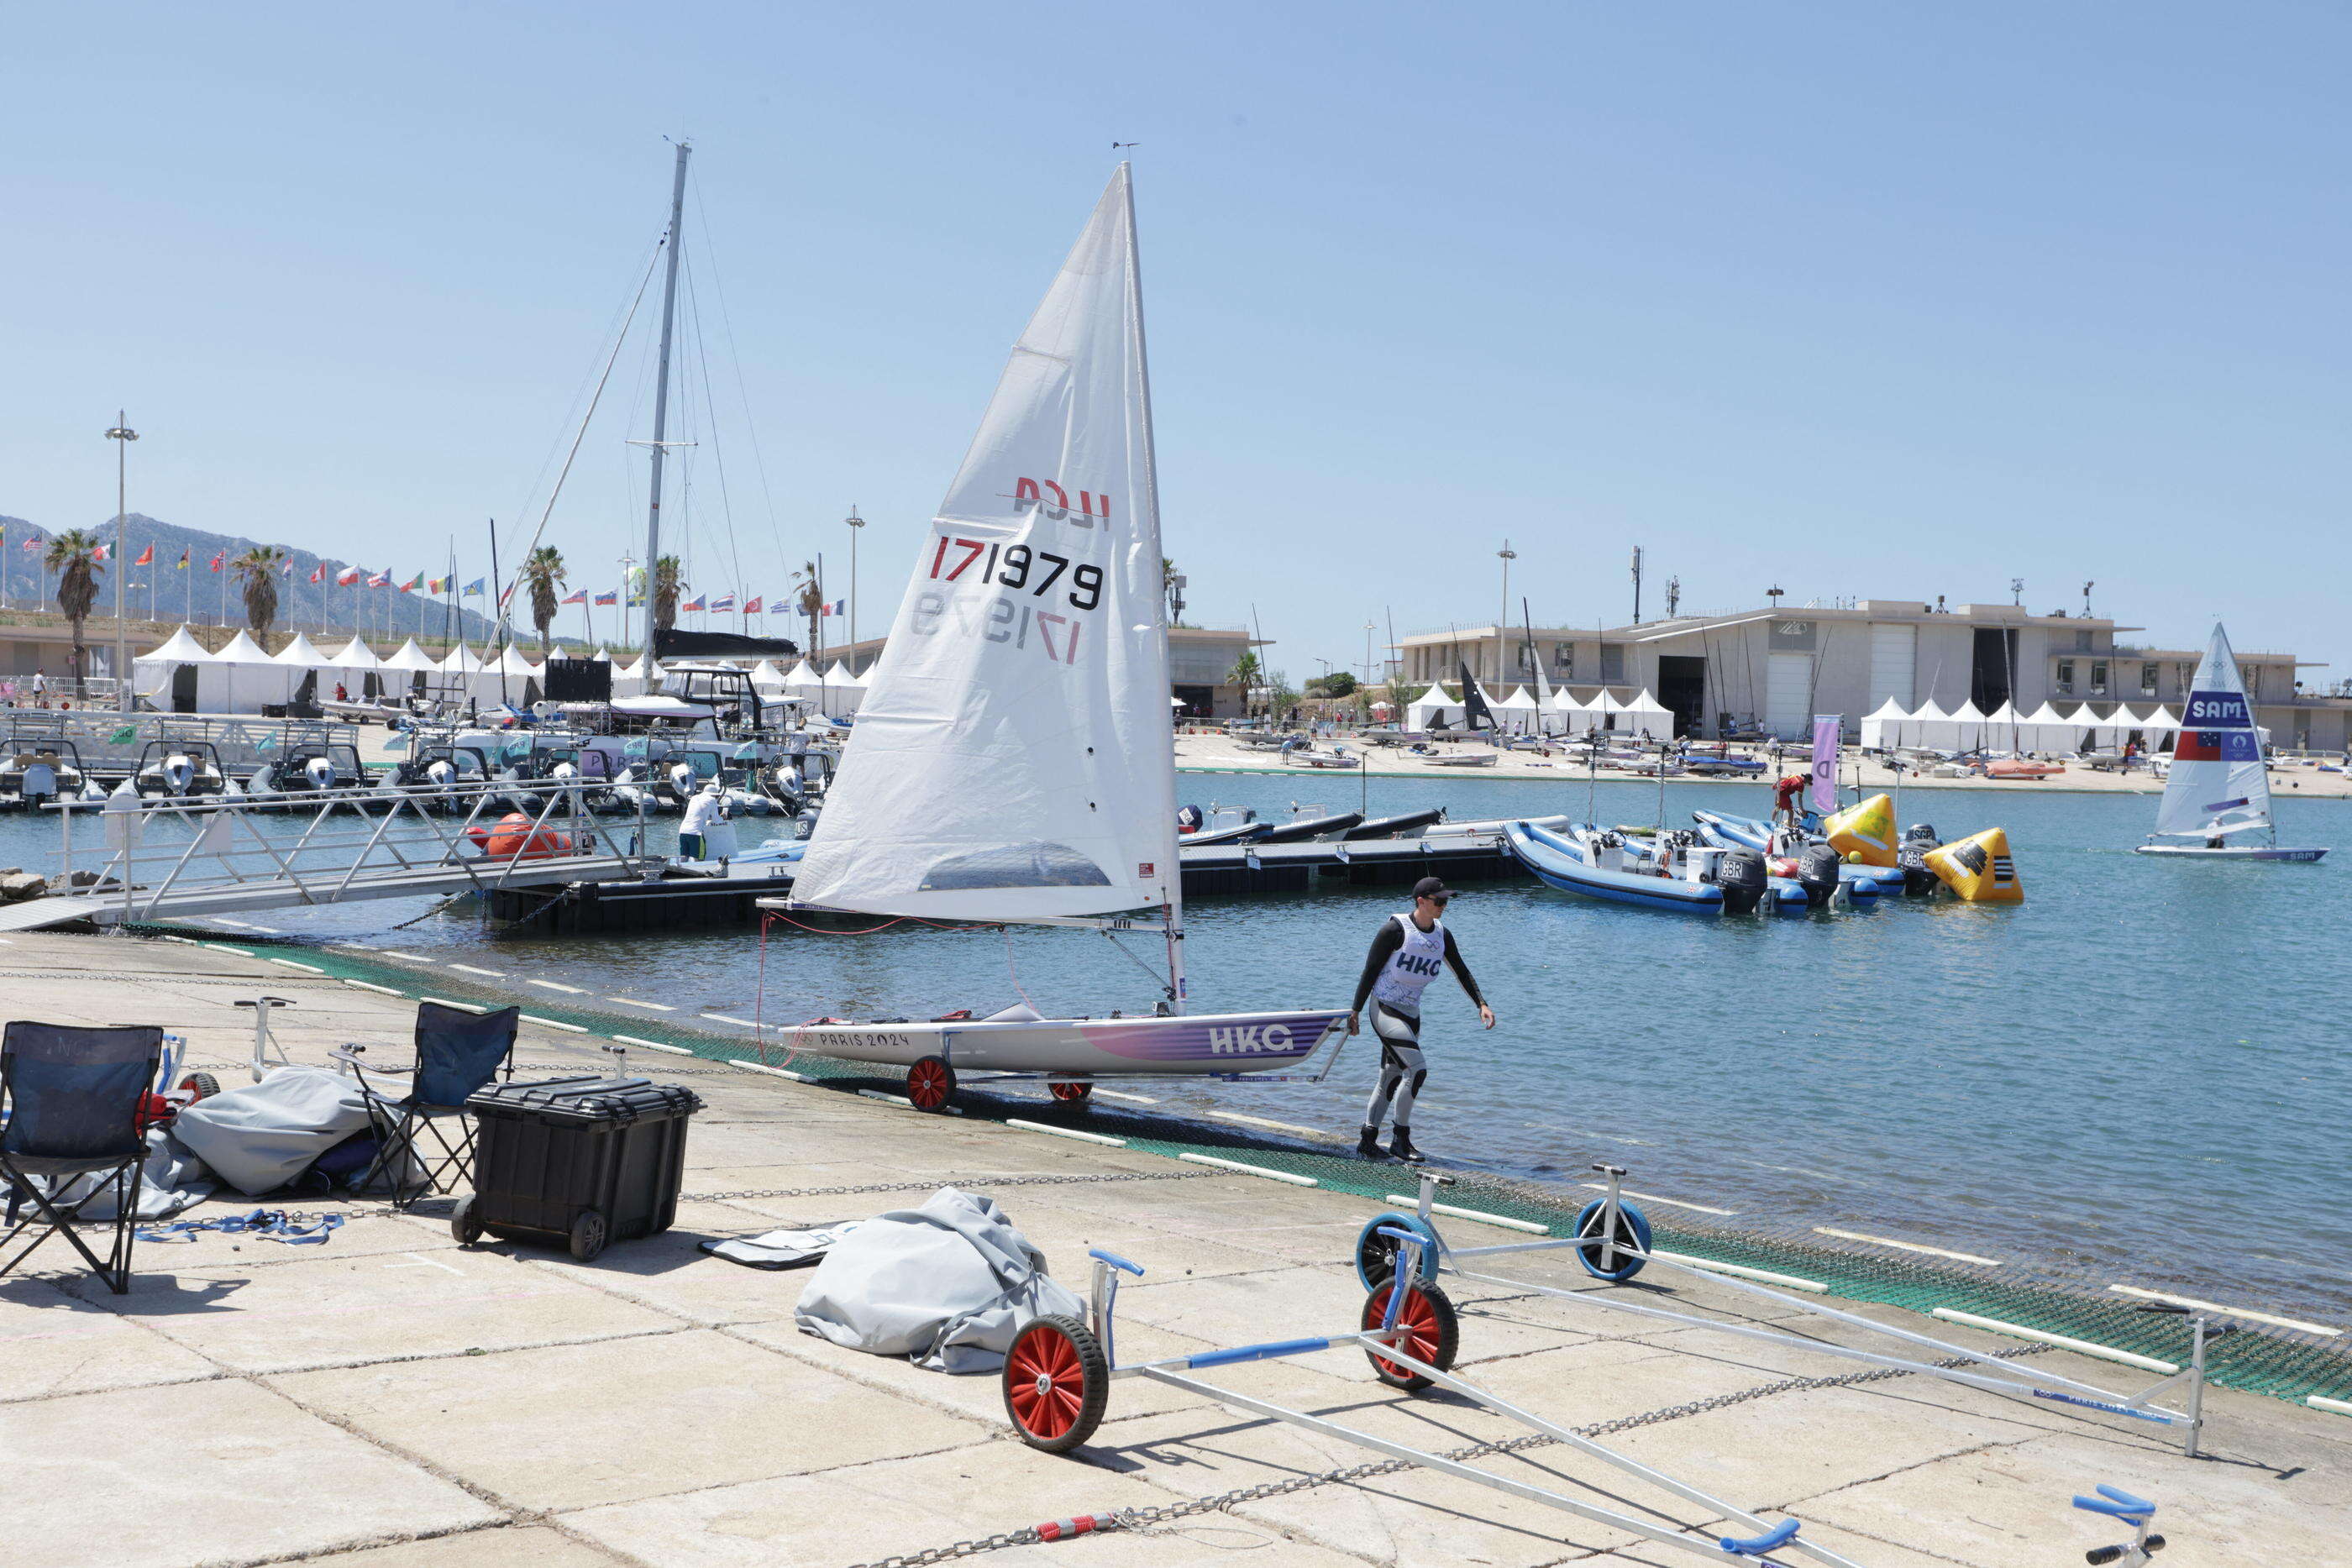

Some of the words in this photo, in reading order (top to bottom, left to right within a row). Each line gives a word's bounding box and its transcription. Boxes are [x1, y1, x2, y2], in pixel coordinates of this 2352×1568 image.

[930, 536, 1104, 611] 171979
[2192, 700, 2241, 719] SAM
[795, 821, 807, 835] US
[1907, 851, 1925, 866] GBR
[2290, 852, 2316, 861] SAM
[1723, 861, 1742, 878] GBR
[820, 1034, 863, 1046] PARIS
[867, 1034, 910, 1046] 2024
[1209, 1024, 1294, 1054] HKG
